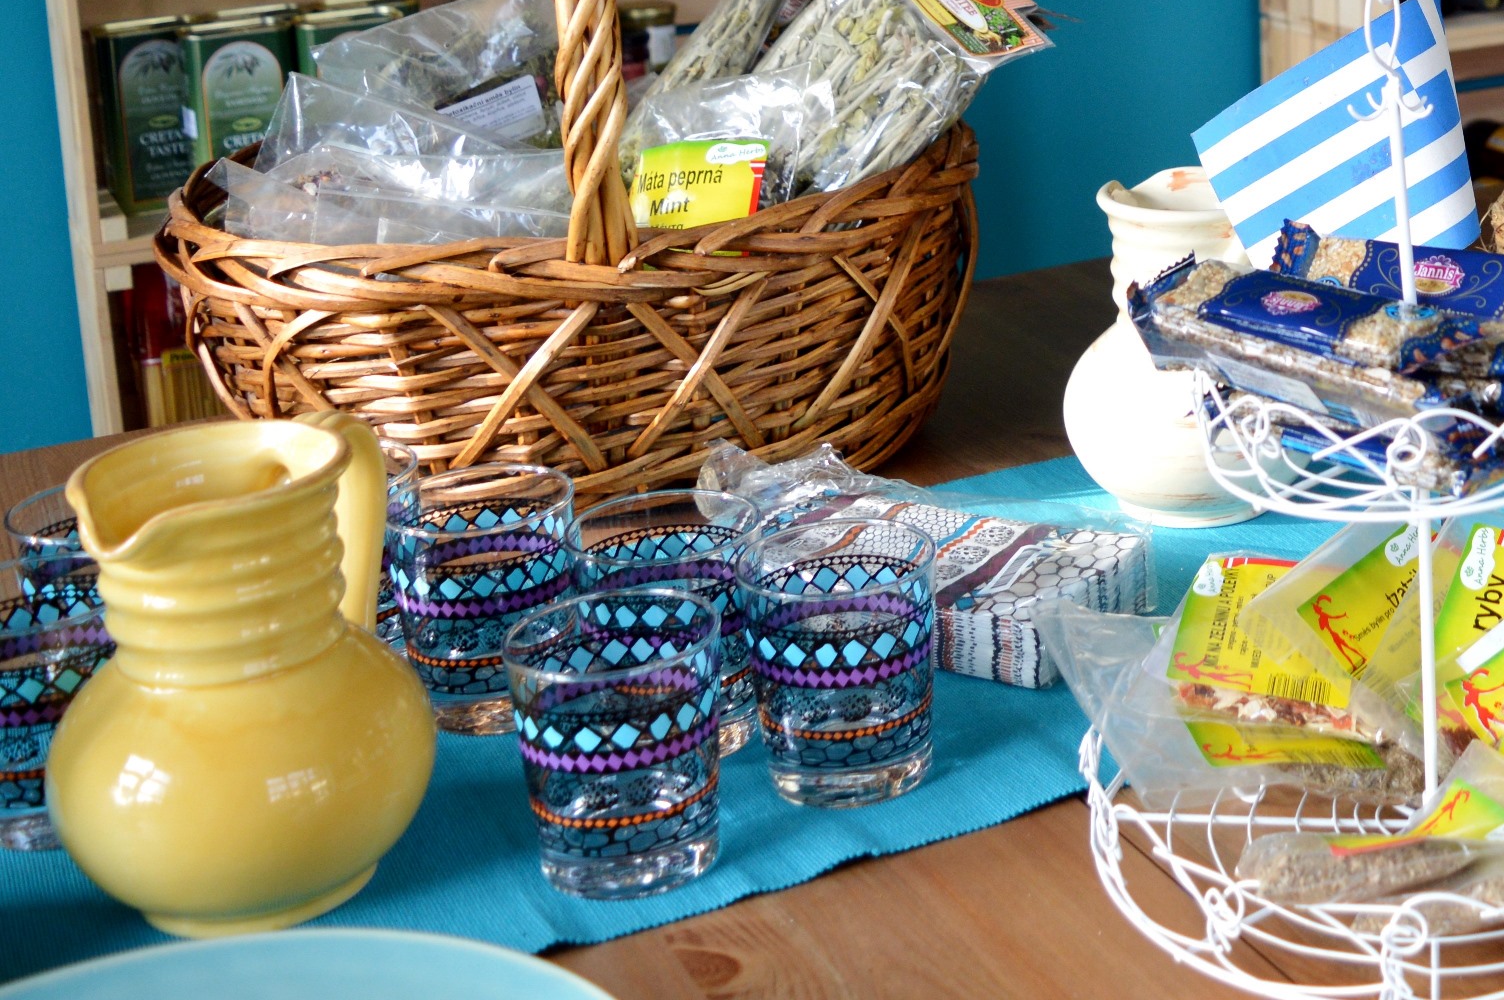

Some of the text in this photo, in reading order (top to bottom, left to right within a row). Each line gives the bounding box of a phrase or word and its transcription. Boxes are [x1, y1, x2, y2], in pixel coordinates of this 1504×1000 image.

[139, 130, 182, 146] CRETA
[711, 147, 765, 161] Anna Herbs
[637, 164, 723, 194] Máta peprná
[650, 197, 690, 217] Mint
[1414, 264, 1455, 281] Jannis
[1395, 543, 1411, 565] Anna
[1474, 527, 1489, 585] Anna Herbs
[1384, 607, 1396, 622] pro
